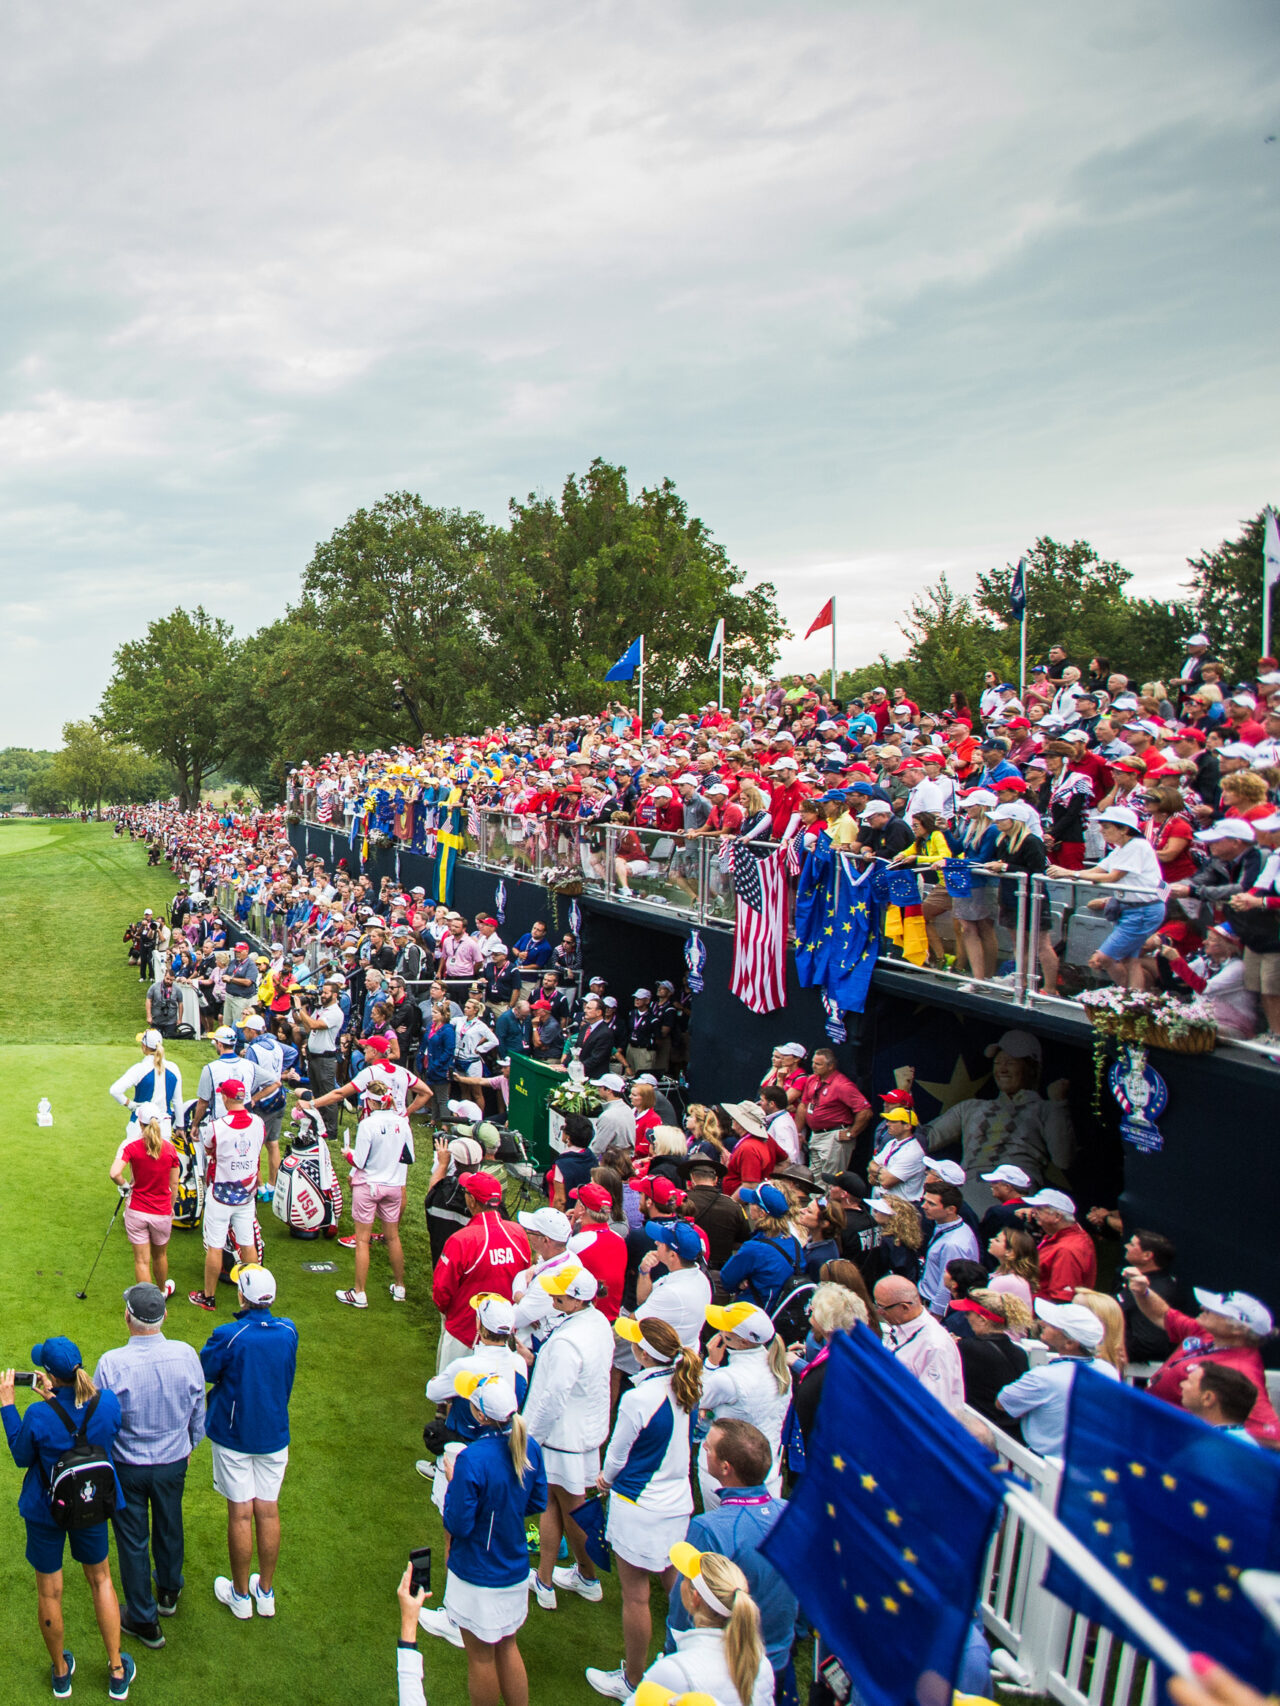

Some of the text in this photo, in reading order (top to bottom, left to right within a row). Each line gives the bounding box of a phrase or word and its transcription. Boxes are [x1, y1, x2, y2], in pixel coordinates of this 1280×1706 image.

[515, 1084, 529, 1097] ROLEX
[381, 1124, 400, 1135] UA
[231, 1160, 254, 1171] ERNST
[297, 1189, 319, 1221] USA
[489, 1247, 515, 1266] USA
